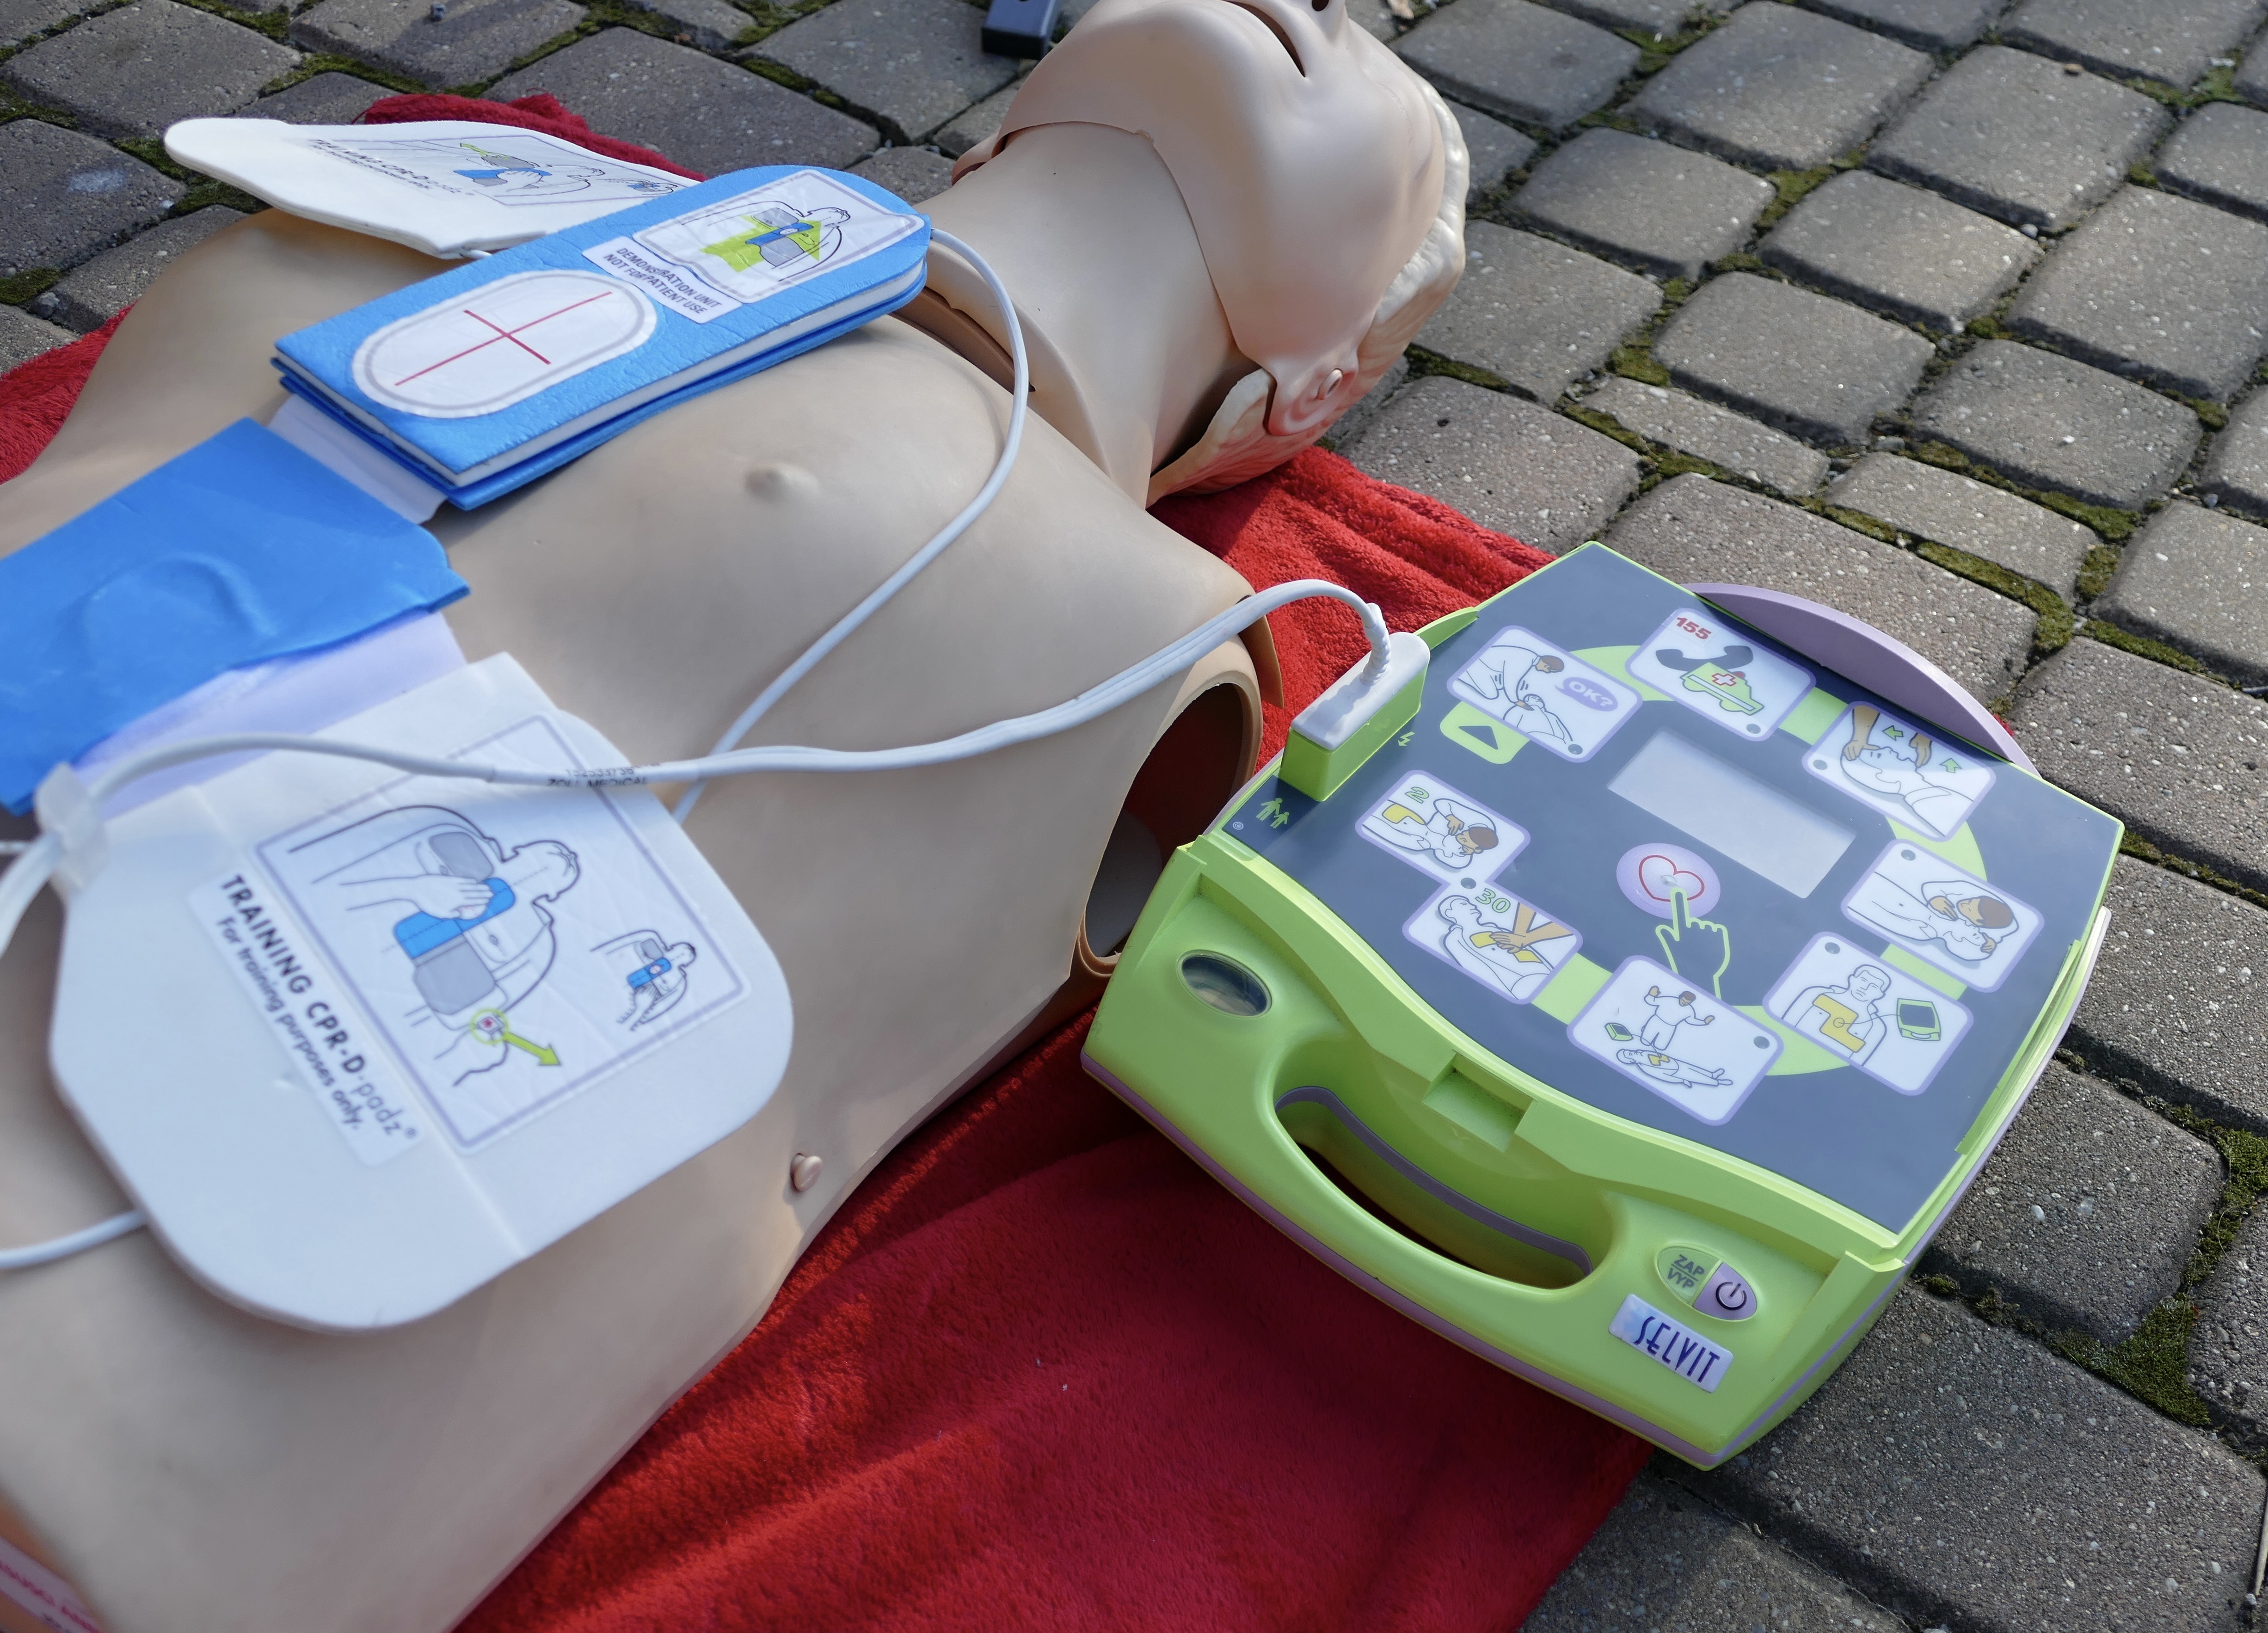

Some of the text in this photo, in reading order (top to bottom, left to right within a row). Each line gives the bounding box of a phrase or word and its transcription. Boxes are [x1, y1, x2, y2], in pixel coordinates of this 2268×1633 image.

[603, 254, 708, 313] NOT FOR PATIENT USE
[694, 294, 722, 307] UNIT
[1677, 617, 1712, 639] 155
[1569, 681, 1613, 706] OK?
[1404, 786, 1430, 804] 2
[1475, 888, 1511, 913] 30
[221, 875, 312, 994] TRAINING
[217, 917, 363, 1130] For training purposes only.
[1674, 1254, 1705, 1276] ZAP
[1667, 1267, 1695, 1289] VYP
[1633, 1316, 1721, 1383] SELVIT
